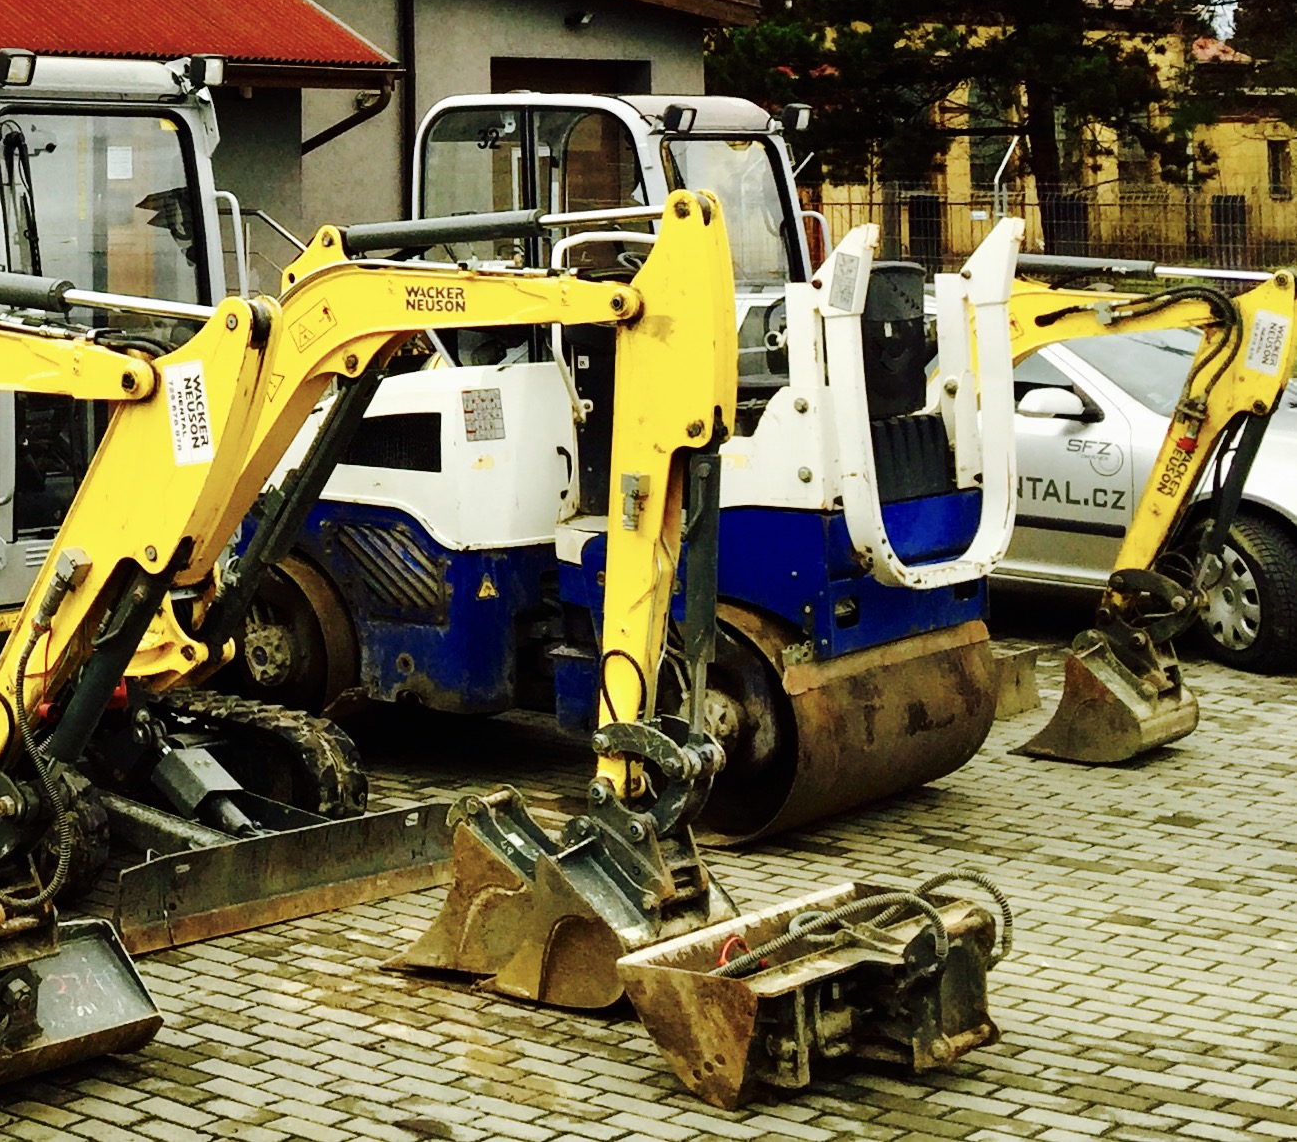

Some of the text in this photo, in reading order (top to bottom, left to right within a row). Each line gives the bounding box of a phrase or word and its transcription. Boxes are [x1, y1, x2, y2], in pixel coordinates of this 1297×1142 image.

[477, 128, 501, 150] 32
[405, 285, 465, 299] WACKER
[406, 299, 466, 312] NEUSON
[1261, 322, 1278, 364] NEUSON
[1269, 325, 1286, 367] WACKER
[177, 391, 187, 437] RENTAL
[183, 377, 200, 449] NEUSON
[192, 374, 209, 447] WACKER
[1066, 438, 1112, 456] SFZ
[1156, 448, 1183, 495] EUSON
